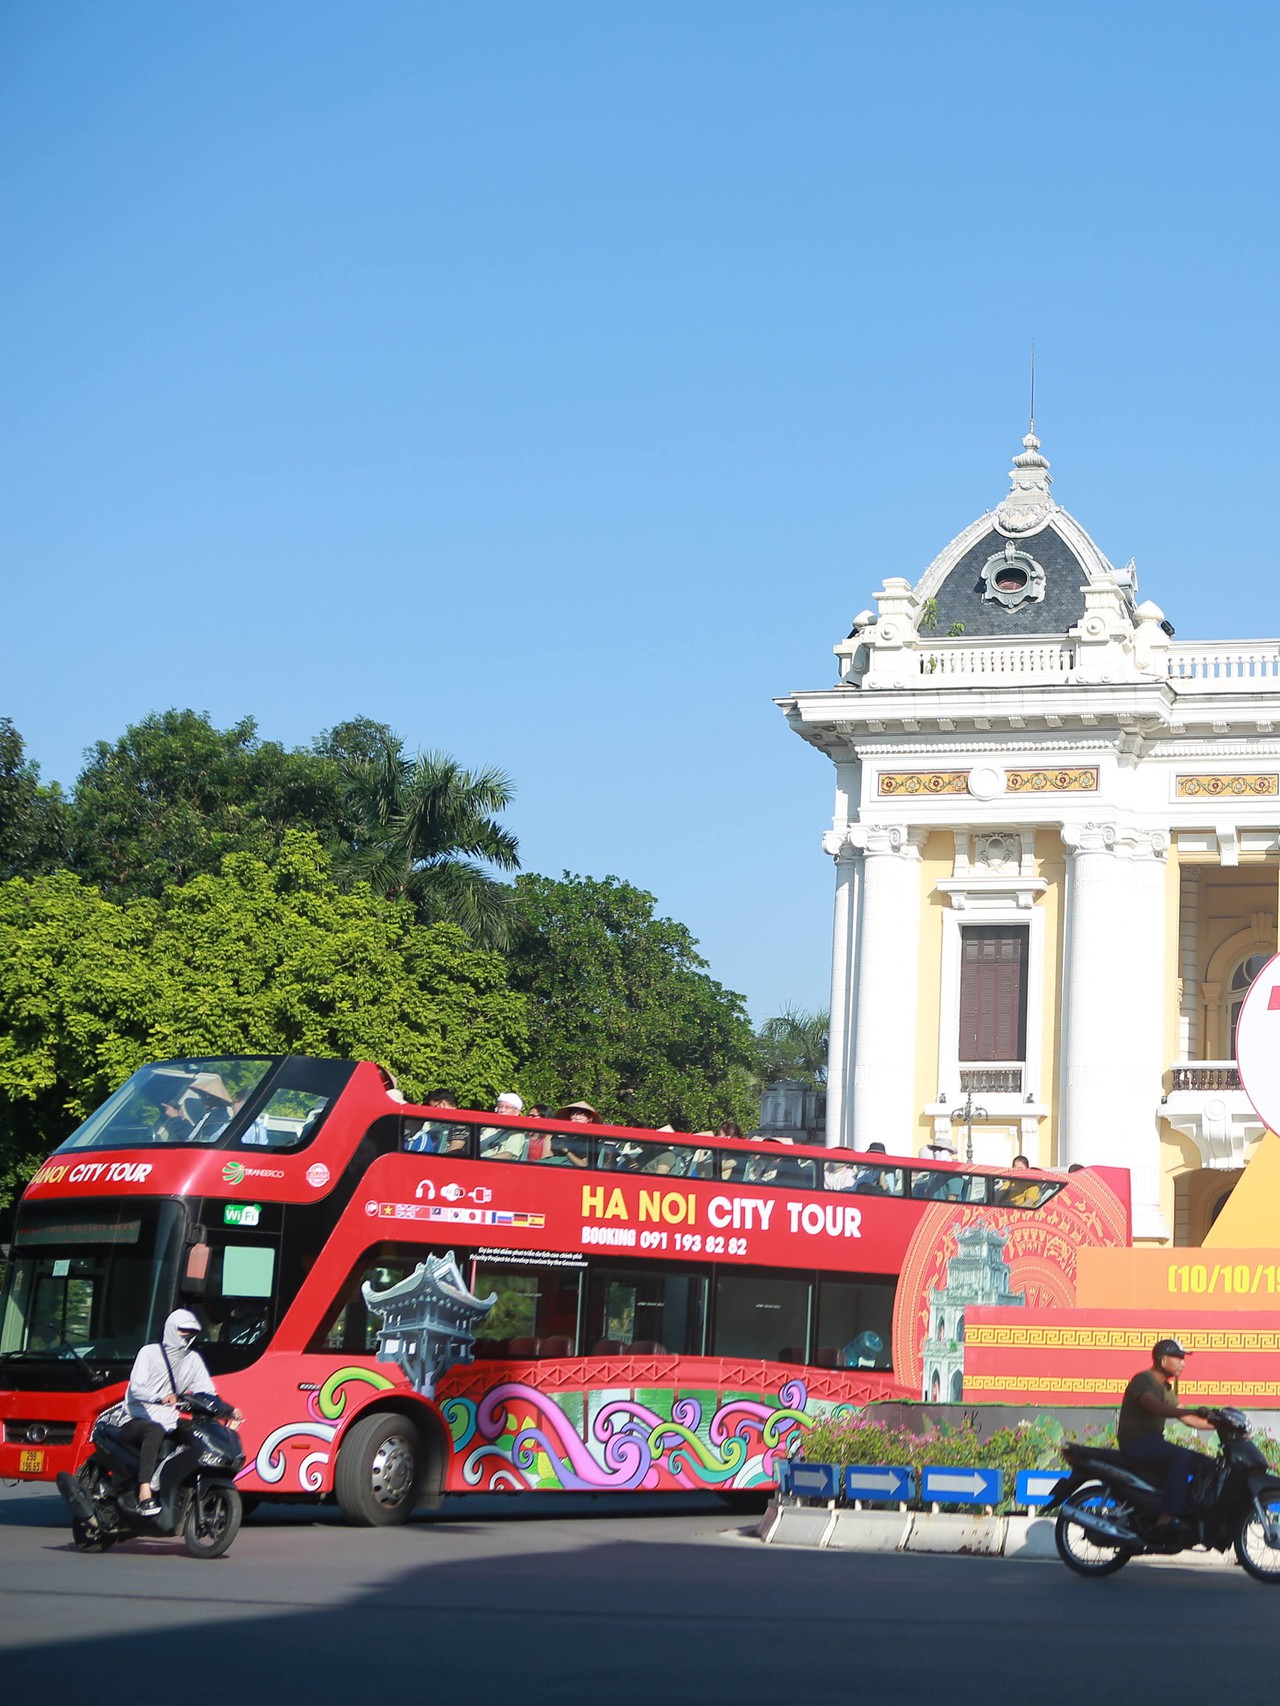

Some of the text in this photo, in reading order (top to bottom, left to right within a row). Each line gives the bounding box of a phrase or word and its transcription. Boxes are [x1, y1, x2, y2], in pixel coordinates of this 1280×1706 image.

[69, 1163, 109, 1183] CITY
[105, 1163, 153, 1183] TOUR
[581, 1185, 862, 1238] HA NOI CITY TOUR
[581, 1226, 747, 1256] BOOKING 091 193 82 82
